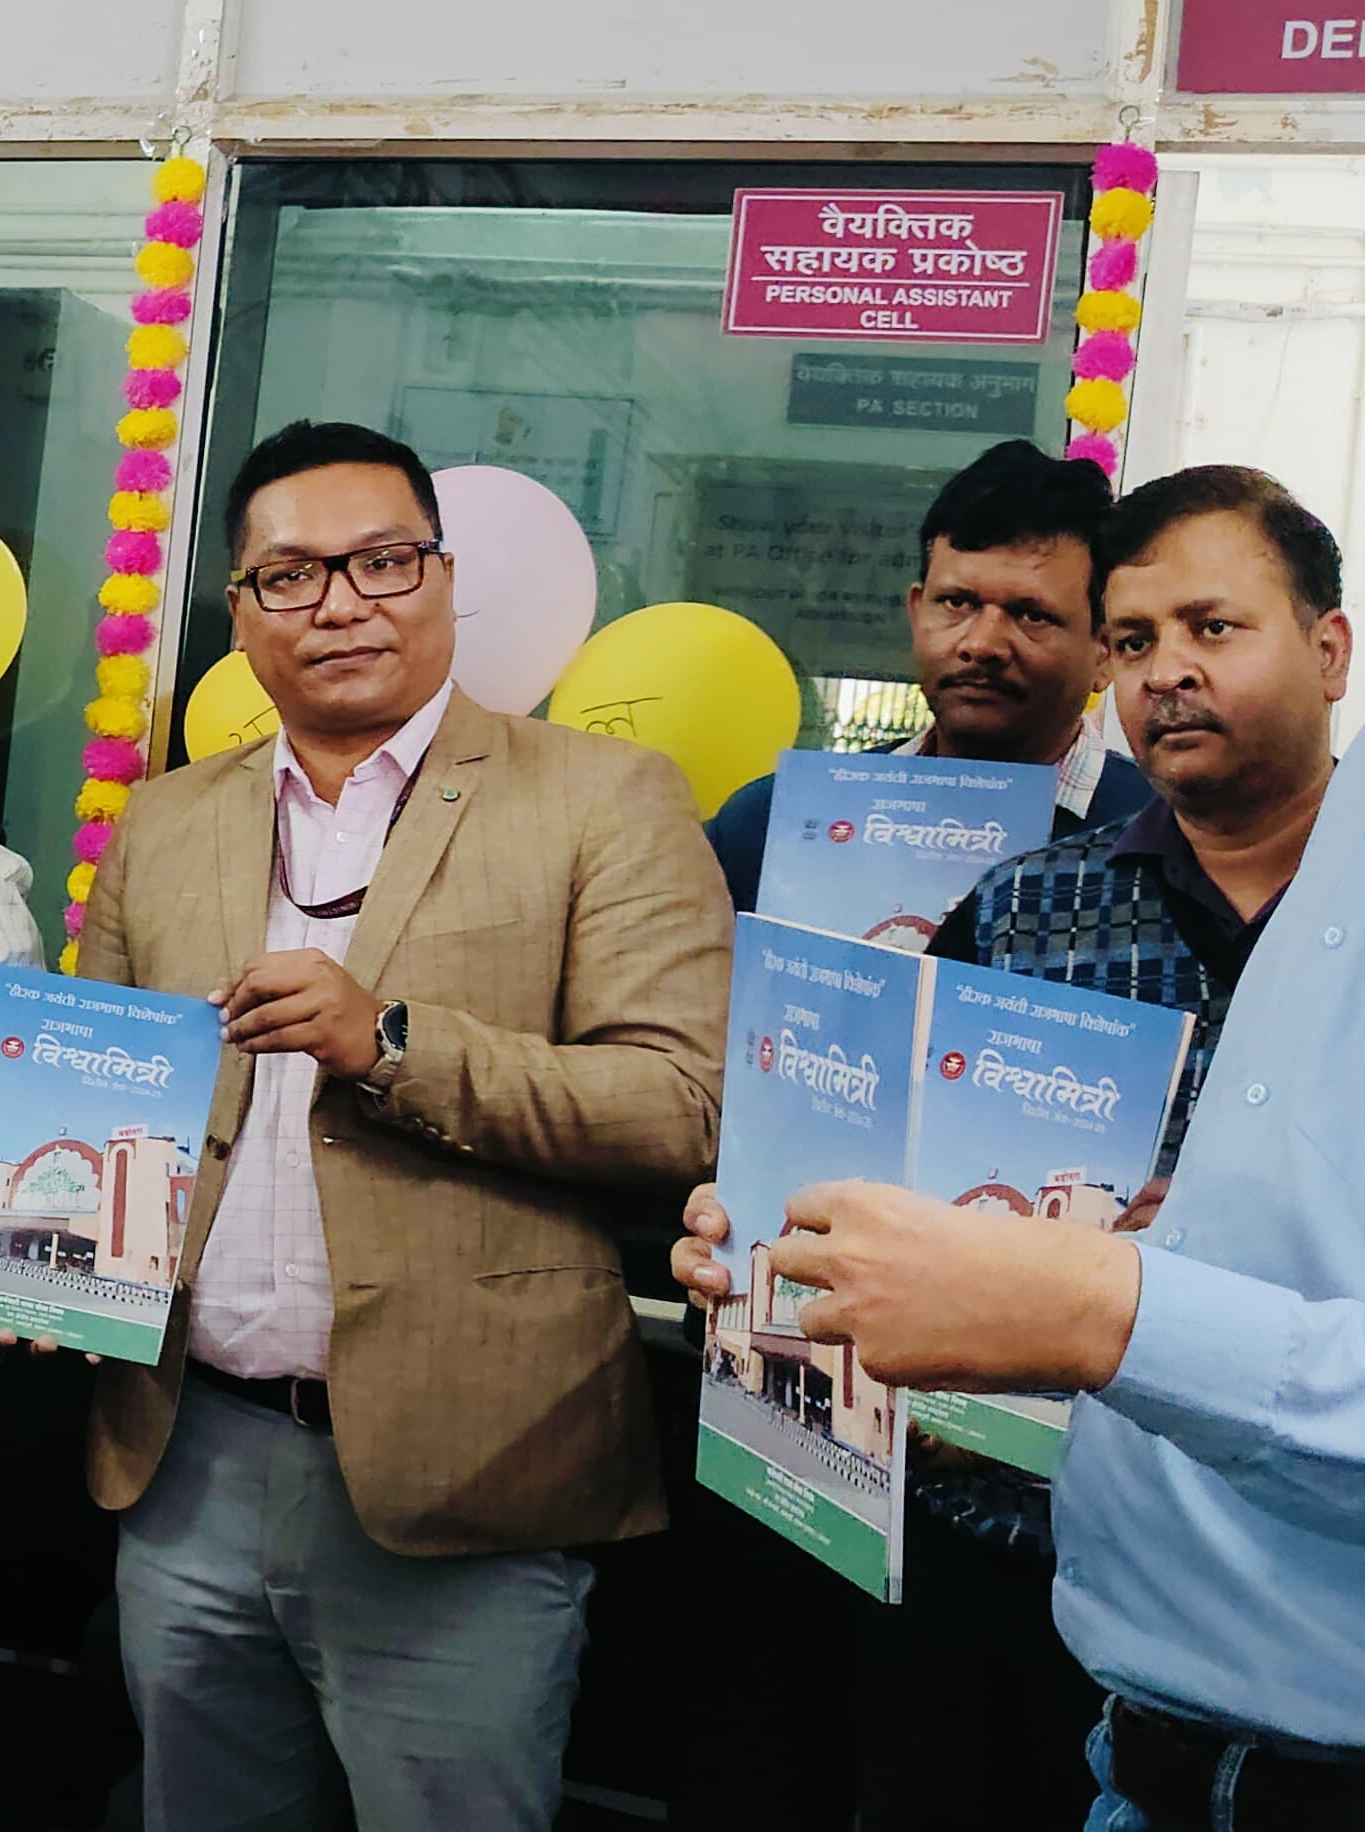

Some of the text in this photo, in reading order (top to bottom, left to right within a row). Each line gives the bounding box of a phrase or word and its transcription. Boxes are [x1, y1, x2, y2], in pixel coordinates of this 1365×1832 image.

[1281, 19, 1365, 59] DE
[819, 202, 974, 242] वैयक्तिक
[760, 240, 1028, 277] सहायक प्रकोष्ठ
[765, 285, 1013, 308] PERSONAL ASSISTANT
[859, 310, 919, 330] CELL
[857, 398, 979, 420] PA SECTION
[862, 813, 1007, 853] विश्वामित्री
[32, 1033, 174, 1089] विश्वामित्री
[778, 1027, 880, 1111] विश्वामित्री
[972, 1048, 1121, 1122] विश्वामित्री
